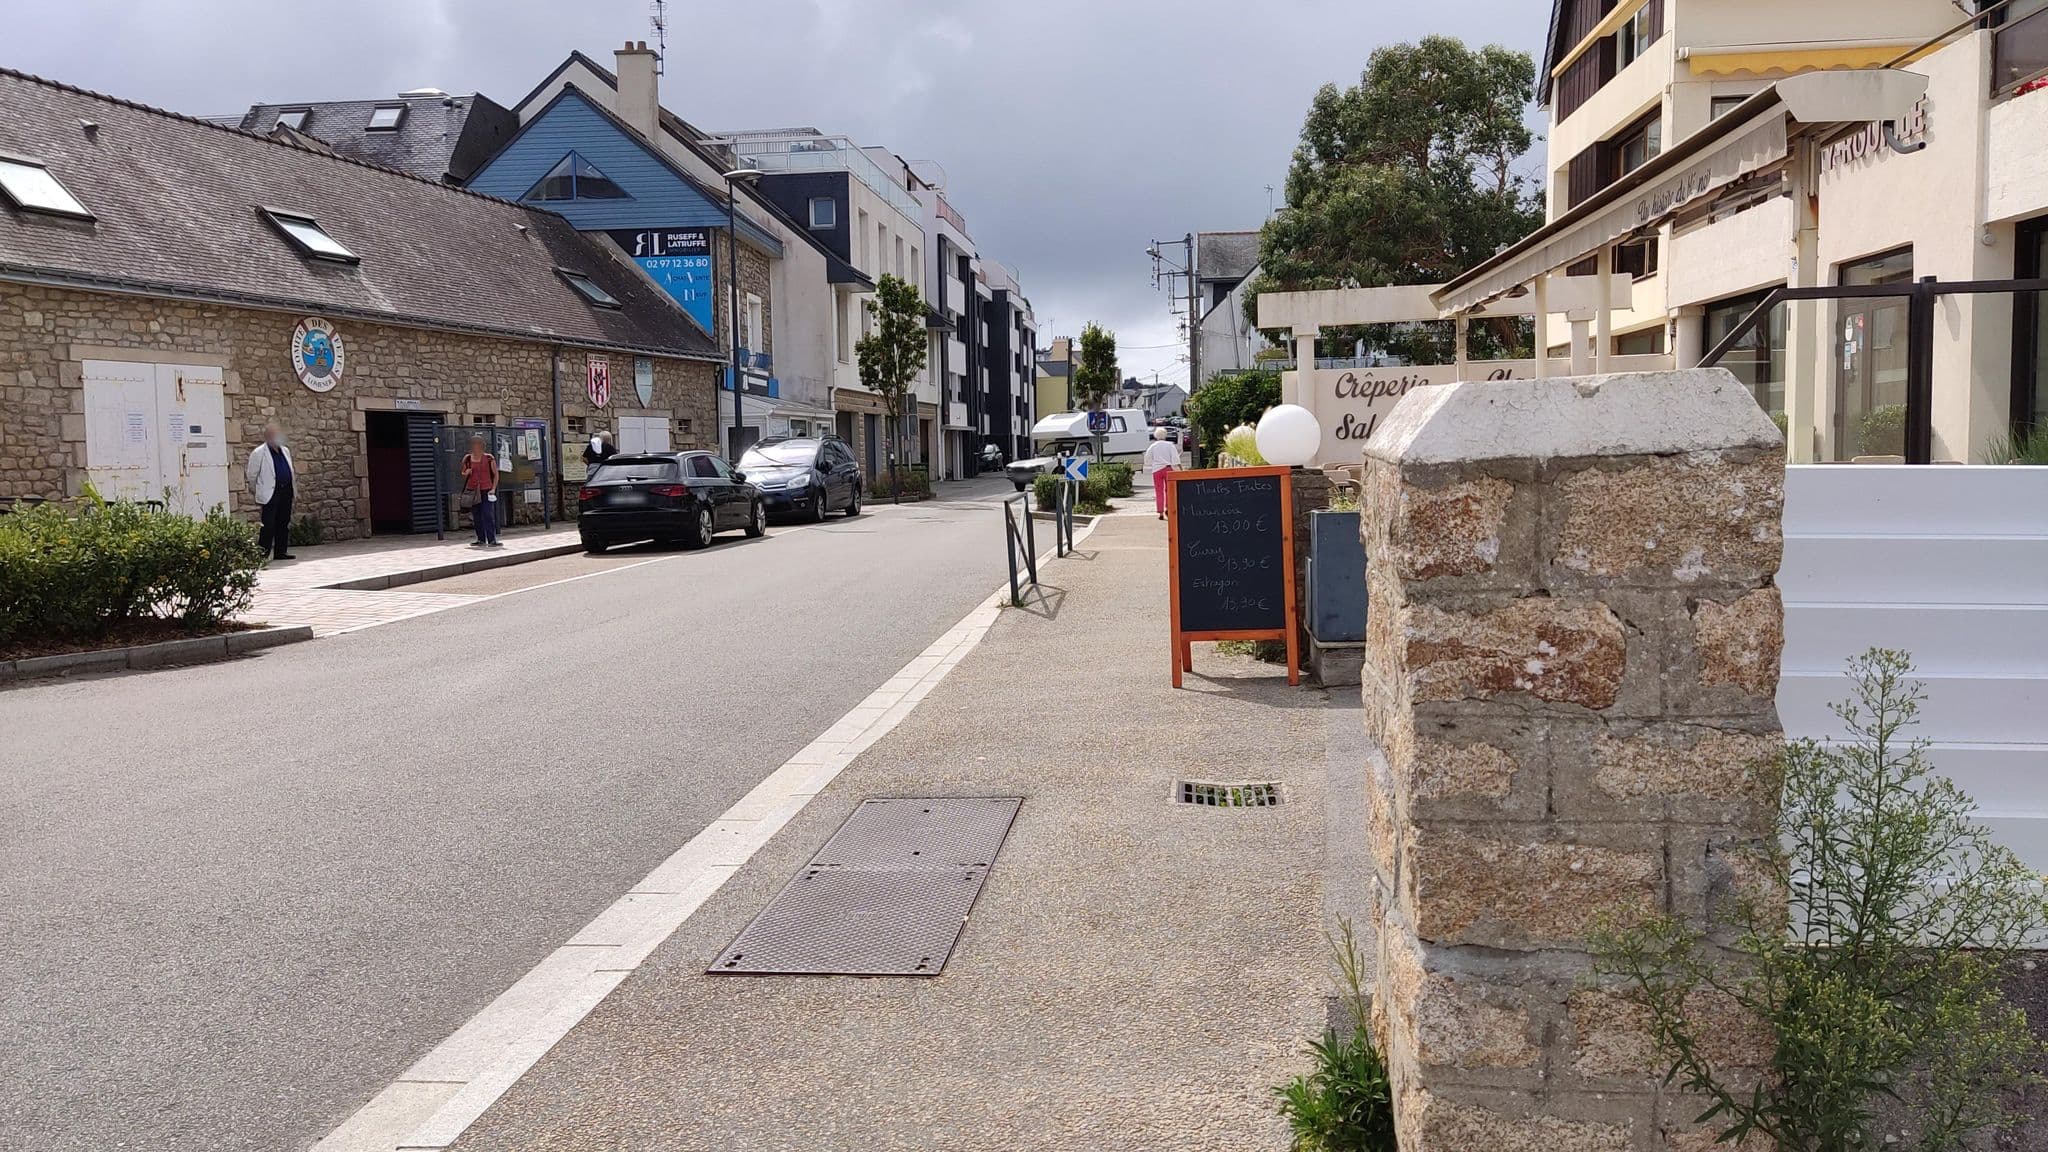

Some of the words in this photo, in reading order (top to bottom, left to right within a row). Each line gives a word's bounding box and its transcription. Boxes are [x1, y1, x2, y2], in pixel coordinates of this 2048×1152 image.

[667, 233, 697, 241] RUSEFF
[698, 232, 705, 240] &
[668, 240, 706, 248] LATRUFFE
[646, 259, 658, 269] 02
[659, 259, 670, 269] 97
[672, 259, 681, 268] 12
[683, 258, 694, 268] 36
[695, 258, 708, 267] 80
[311, 319, 329, 331] DES
